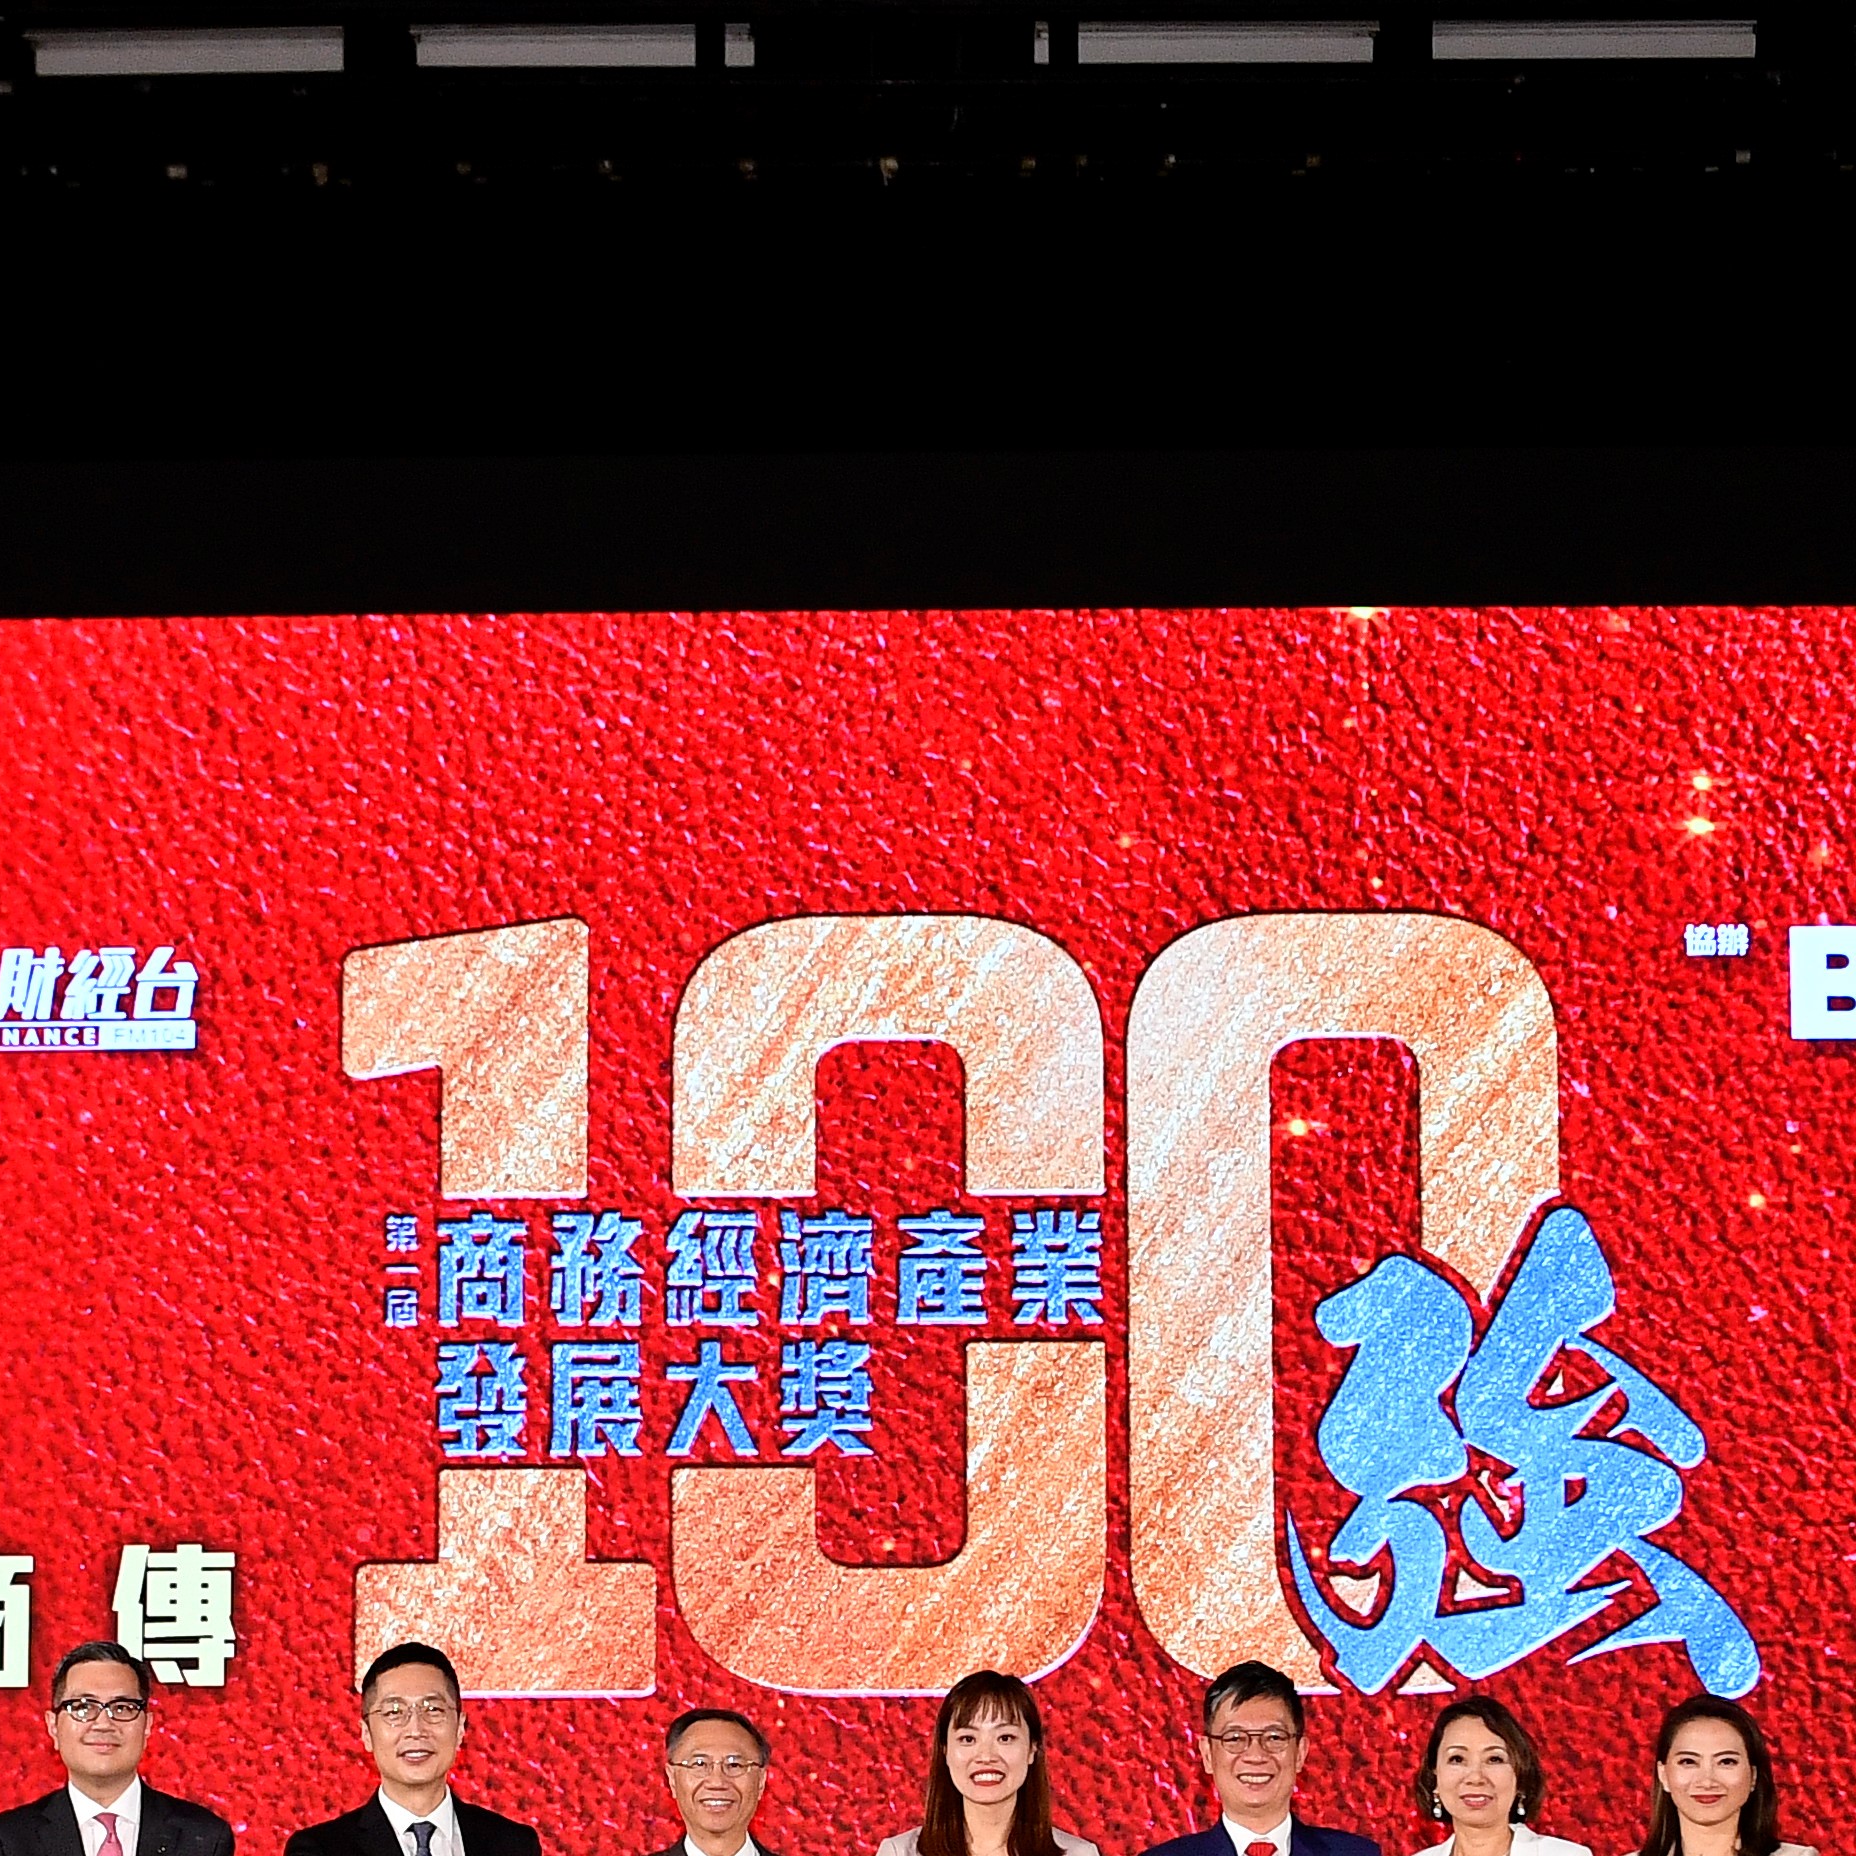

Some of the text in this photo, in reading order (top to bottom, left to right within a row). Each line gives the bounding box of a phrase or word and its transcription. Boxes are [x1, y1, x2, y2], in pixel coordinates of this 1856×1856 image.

[436, 1211, 1105, 1327] 商務經濟產業
[434, 1341, 875, 1457] 發展大獎
